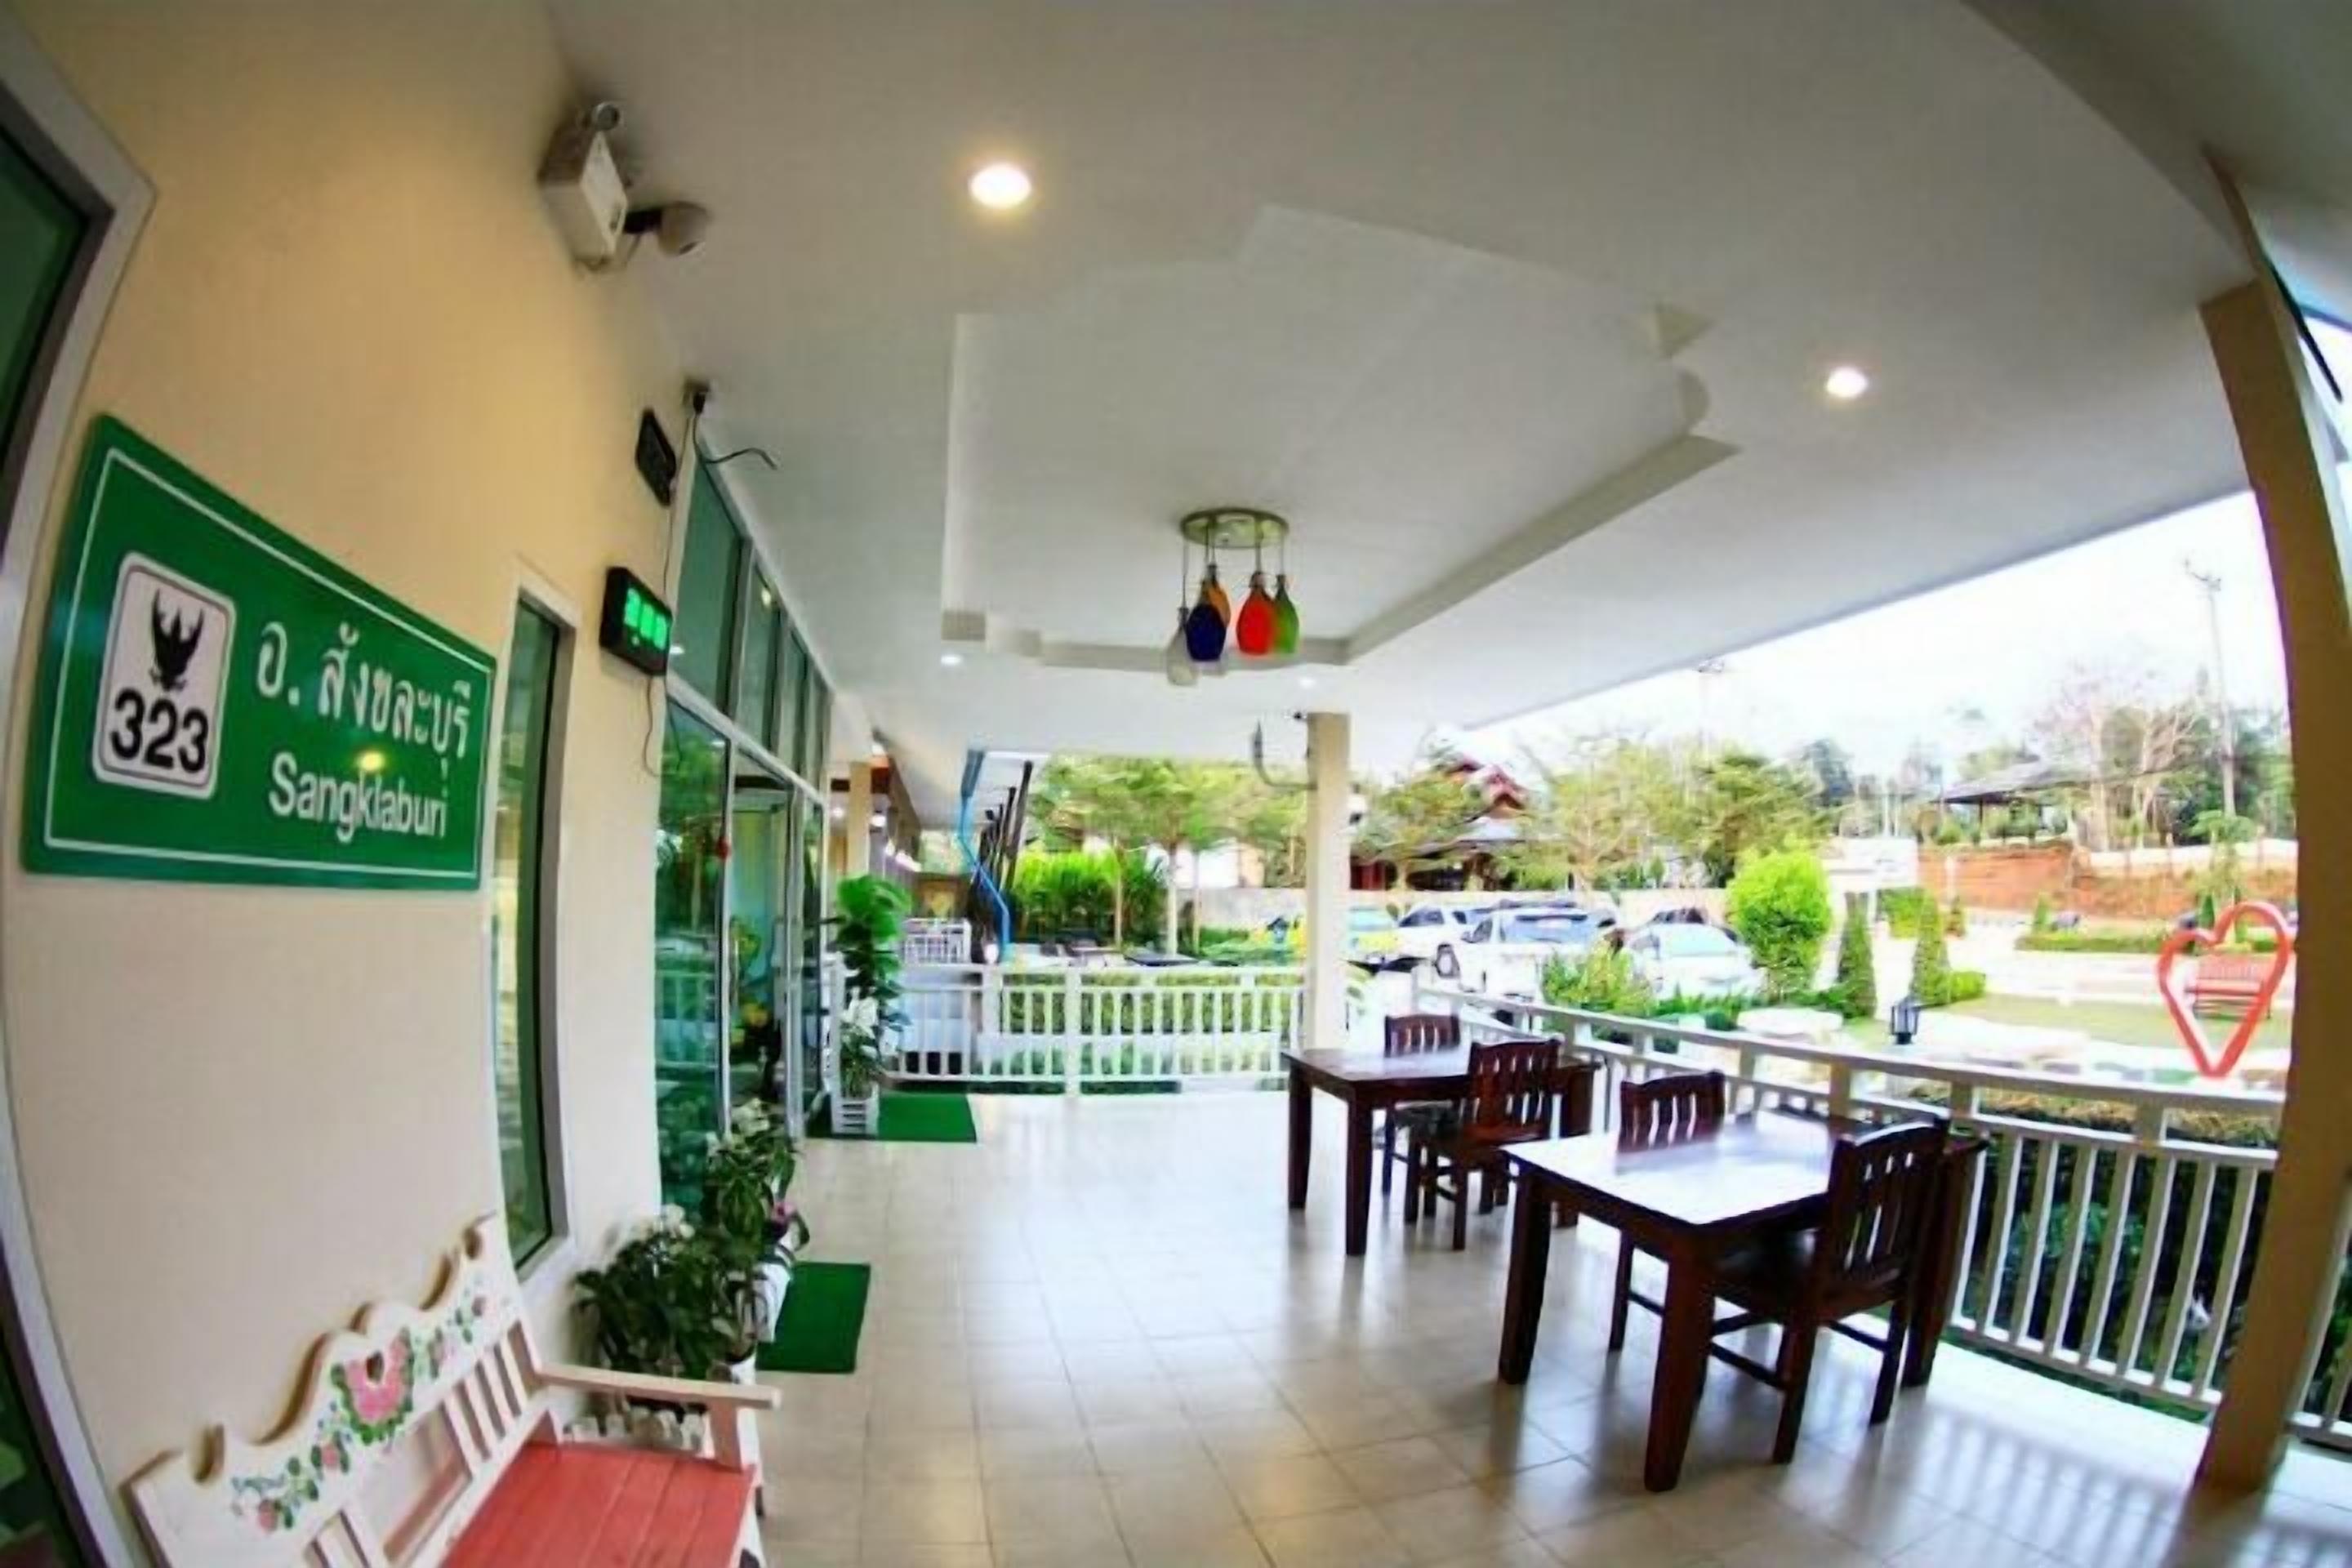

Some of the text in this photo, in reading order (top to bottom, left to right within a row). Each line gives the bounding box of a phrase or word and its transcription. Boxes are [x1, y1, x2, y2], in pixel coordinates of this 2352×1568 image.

[256, 621, 301, 707] อ.
[110, 688, 210, 773] 323
[268, 751, 448, 844] Sangklaburi
